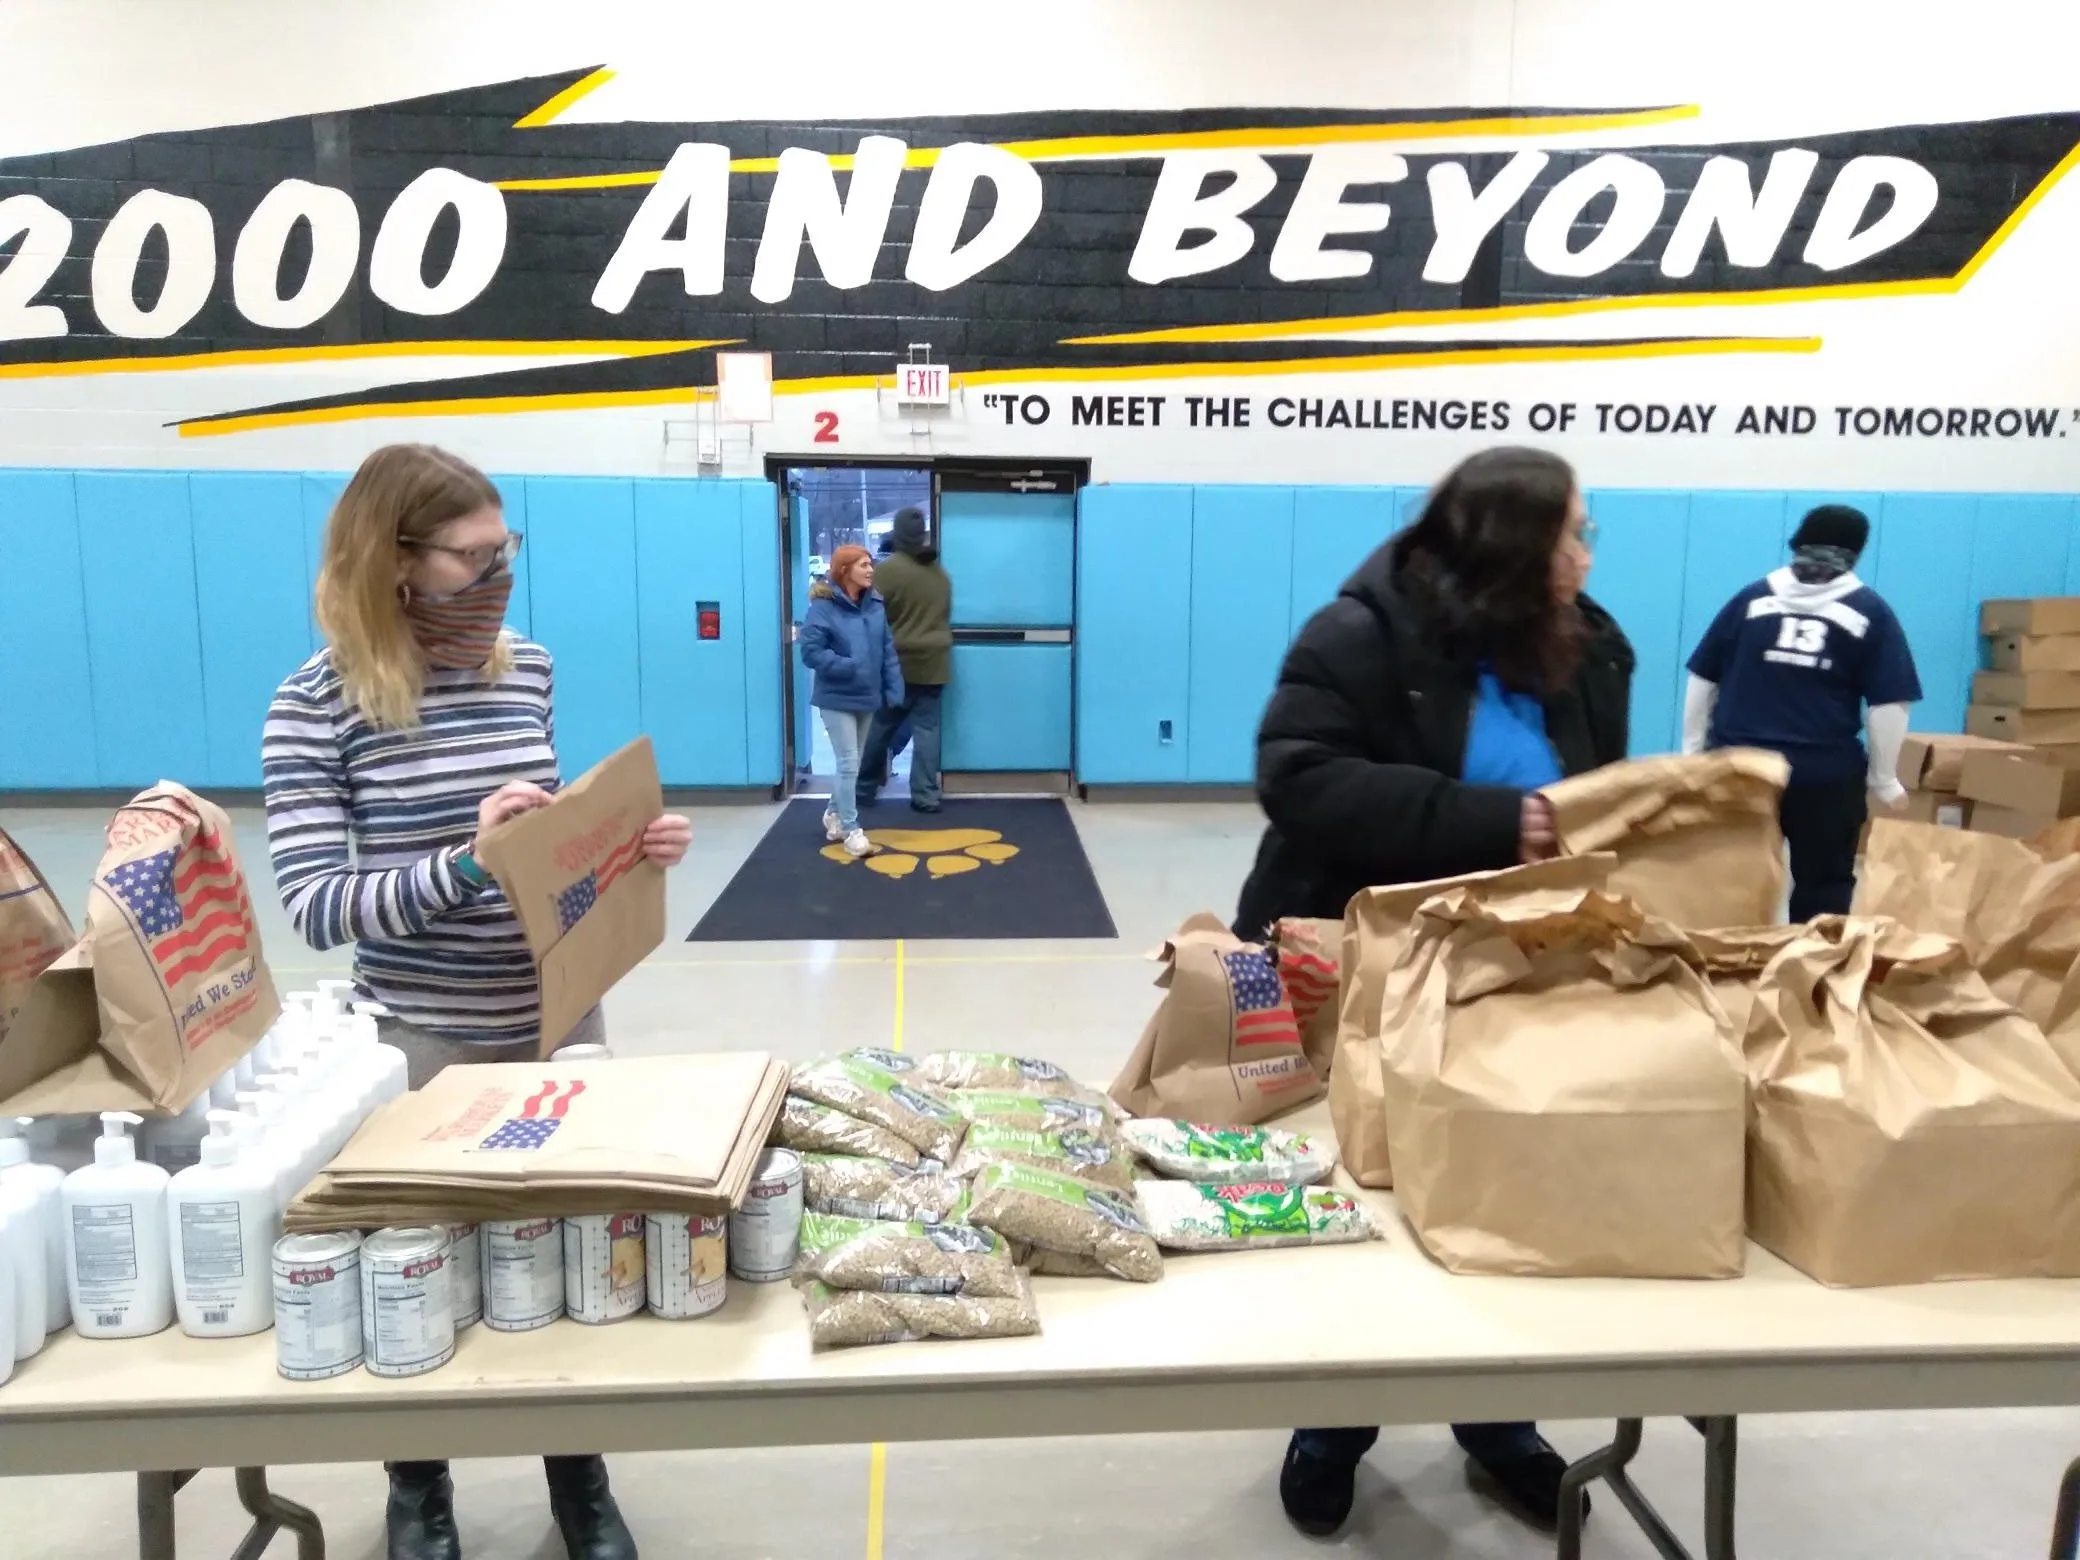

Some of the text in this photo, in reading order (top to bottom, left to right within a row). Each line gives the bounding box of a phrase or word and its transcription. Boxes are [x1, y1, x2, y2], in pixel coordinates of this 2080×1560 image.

[0, 135, 1939, 340] 2000 AND BEYOND
[906, 369, 942, 398] EXIT
[814, 411, 840, 442] 2
[1072, 395, 1166, 427] MEET
[1185, 396, 1251, 427] THE
[1267, 397, 1510, 431] CHALLENGES
[1528, 403, 1577, 432] OF
[1595, 404, 1717, 433] TODAY
[1735, 405, 1817, 434] AND
[1776, 616, 1829, 653] 13
[207, 984, 231, 1006] We
[1238, 1059, 1289, 1079] United
[295, 1272, 328, 1284] ROYAL
[411, 1261, 441, 1277] ROYAL
